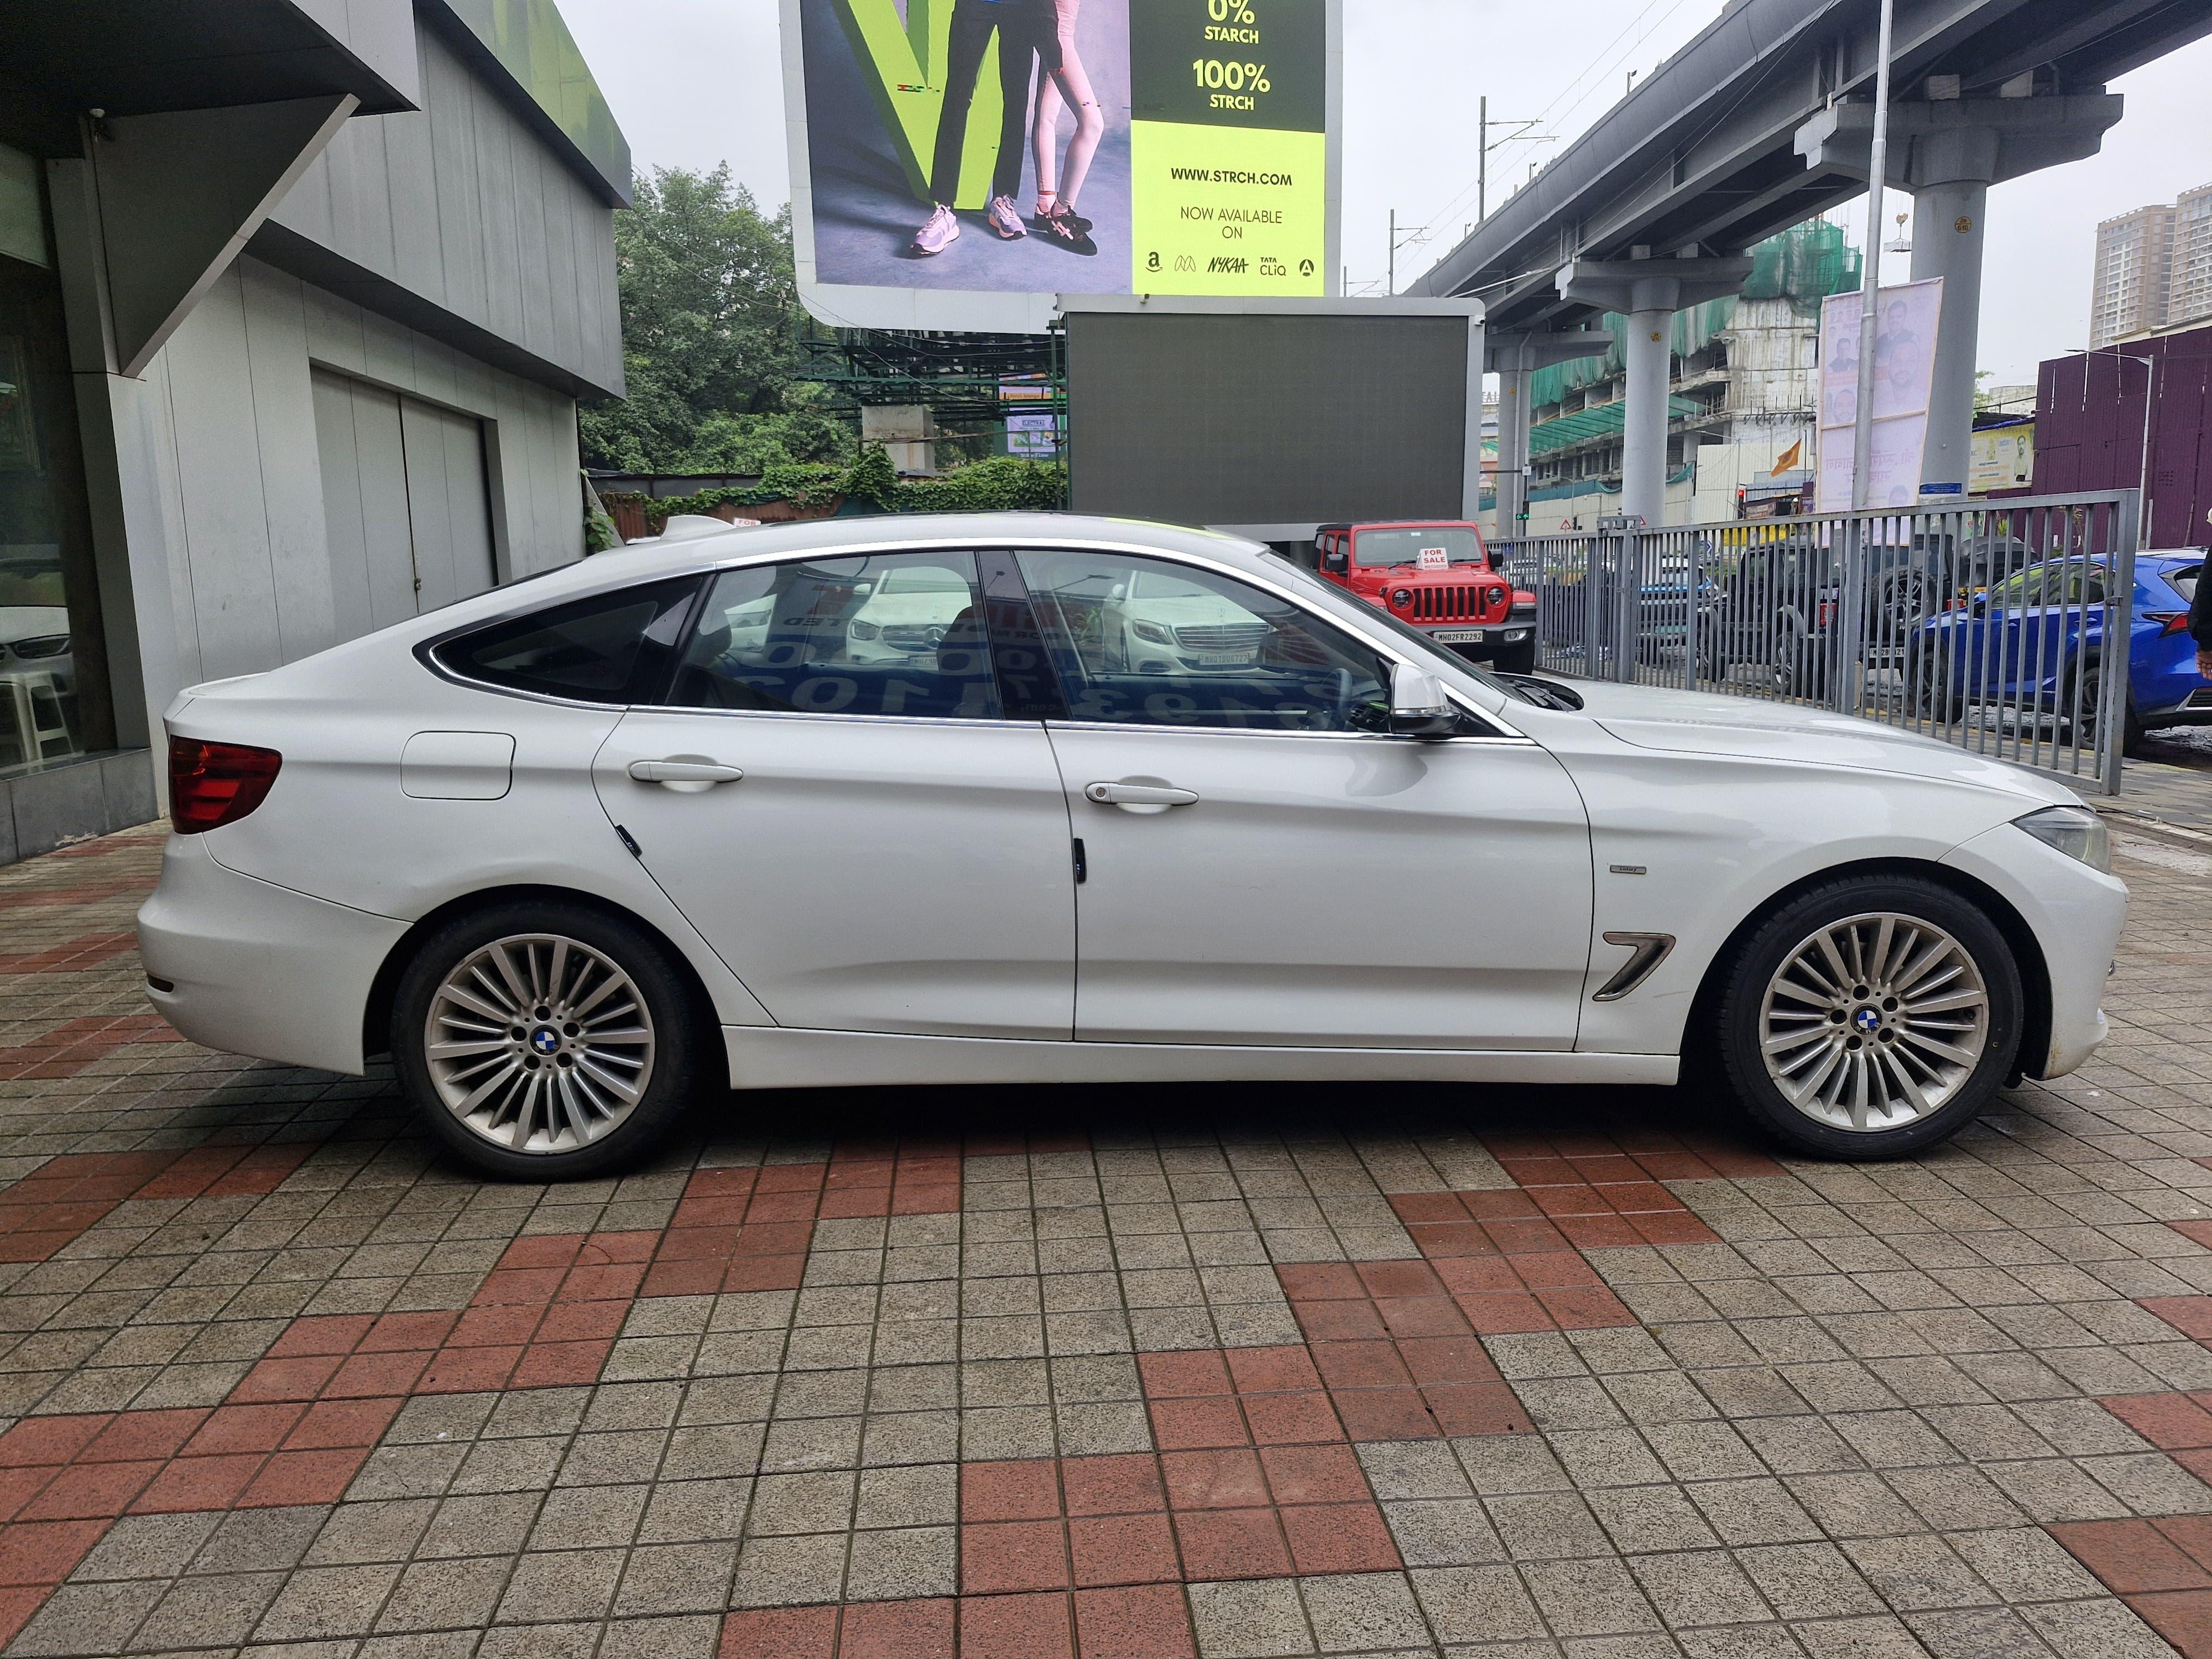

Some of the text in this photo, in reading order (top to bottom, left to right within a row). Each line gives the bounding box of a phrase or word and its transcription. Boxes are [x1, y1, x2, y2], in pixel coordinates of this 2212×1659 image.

[1208, 0, 1255, 24] 0%
[1204, 25, 1259, 44] STARCH
[1192, 59, 1271, 93] 100%
[1209, 93, 1254, 111] STRCH
[1171, 168, 1292, 186] WWW.STRCH.COM
[1181, 206, 1282, 223] NOW AVAILABLE
[1222, 226, 1242, 239] ON
[1207, 257, 1249, 273] NYKAA
[1438, 633, 1481, 641] MH02FR2292
